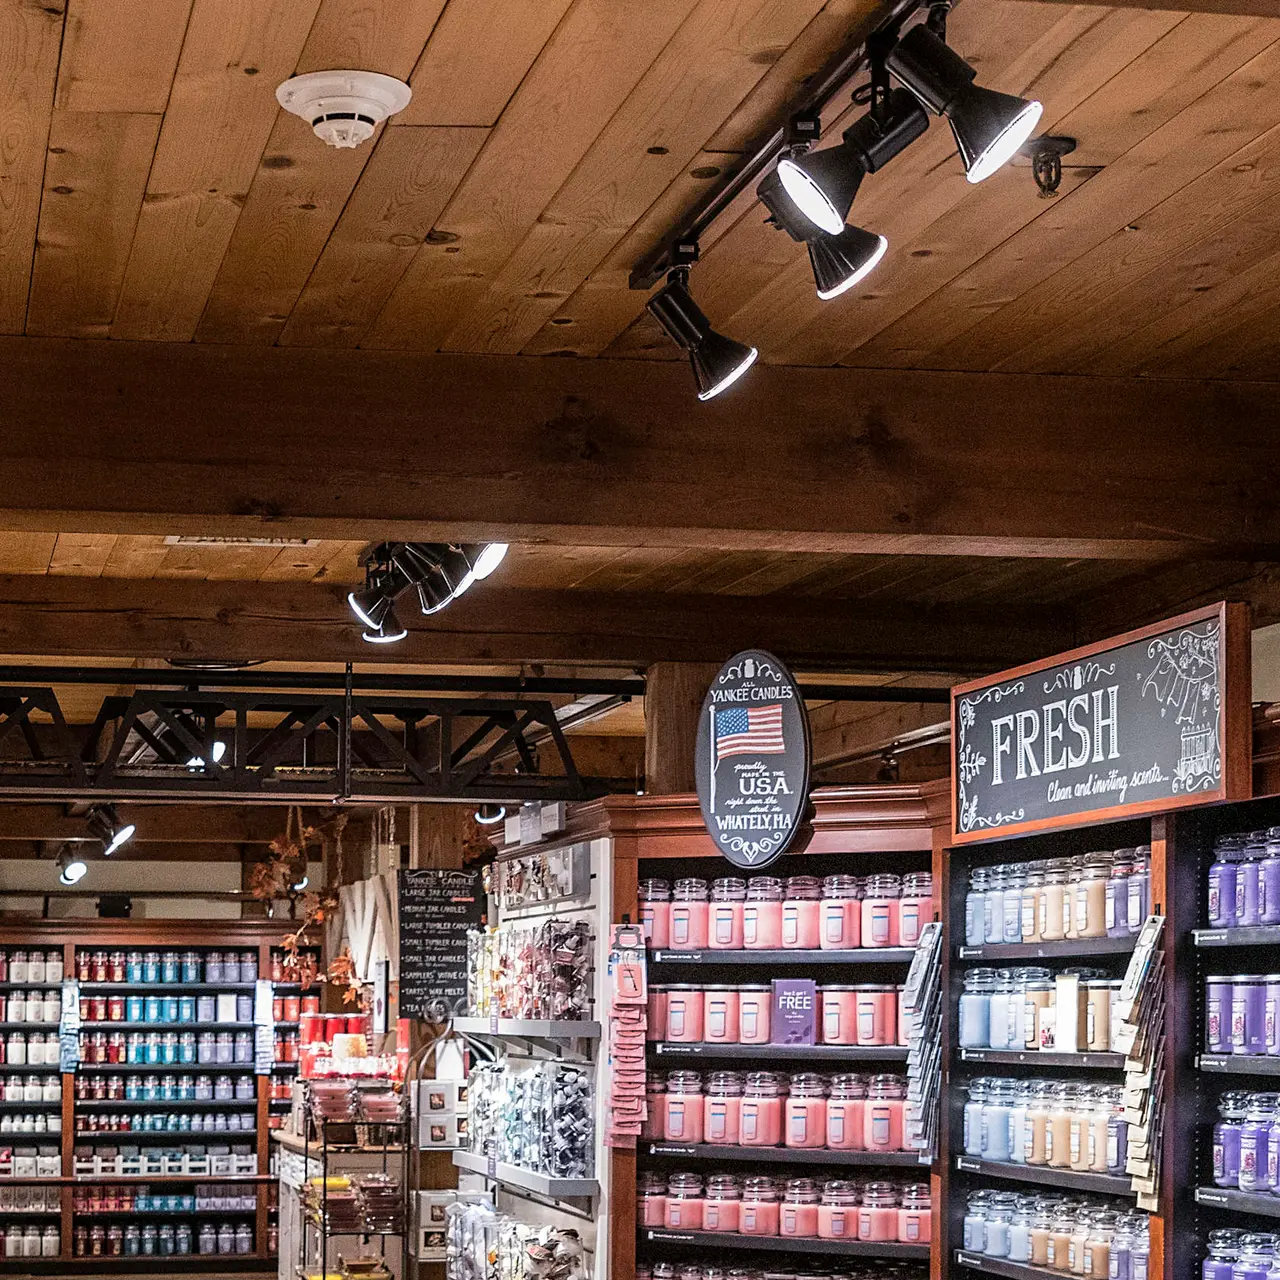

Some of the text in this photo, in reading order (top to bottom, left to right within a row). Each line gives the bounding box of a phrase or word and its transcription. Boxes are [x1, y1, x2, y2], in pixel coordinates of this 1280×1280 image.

[710, 685, 793, 703] YANKEE CANDLES
[990, 684, 1121, 786] FRESH
[734, 761, 767, 772] proudly
[739, 777, 794, 795] U.S.A.
[1047, 779, 1072, 803] Clean
[1074, 780, 1091, 798] and
[1091, 768, 1128, 804] inviting
[725, 797, 744, 809] right
[764, 796, 778, 805] the
[715, 813, 793, 831] WHATELY, MA
[405, 877, 475, 886] YANKEE CANDLE
[404, 888, 426, 897] LARGE
[778, 996, 812, 1009] FREE
